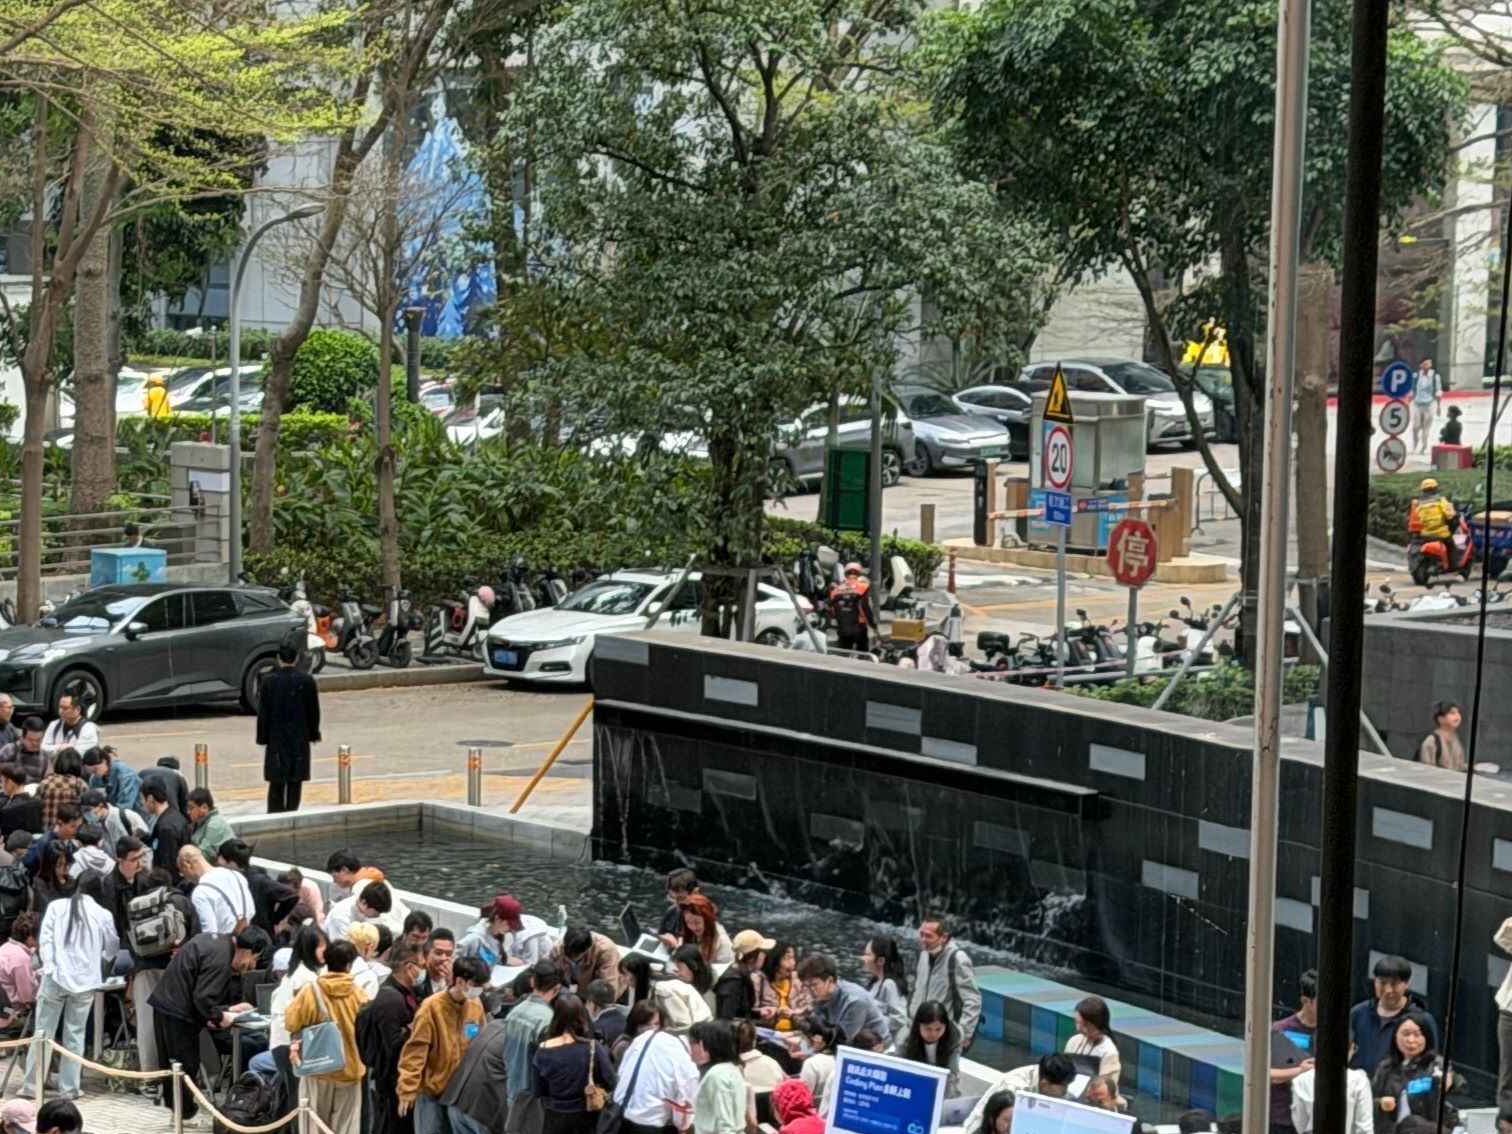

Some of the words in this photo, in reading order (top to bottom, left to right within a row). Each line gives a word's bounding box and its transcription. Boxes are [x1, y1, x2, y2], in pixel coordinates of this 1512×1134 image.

[1390, 369, 1407, 393] P
[1389, 408, 1402, 428] 5
[1052, 443, 1067, 474] 20
[1116, 527, 1150, 578] 停
